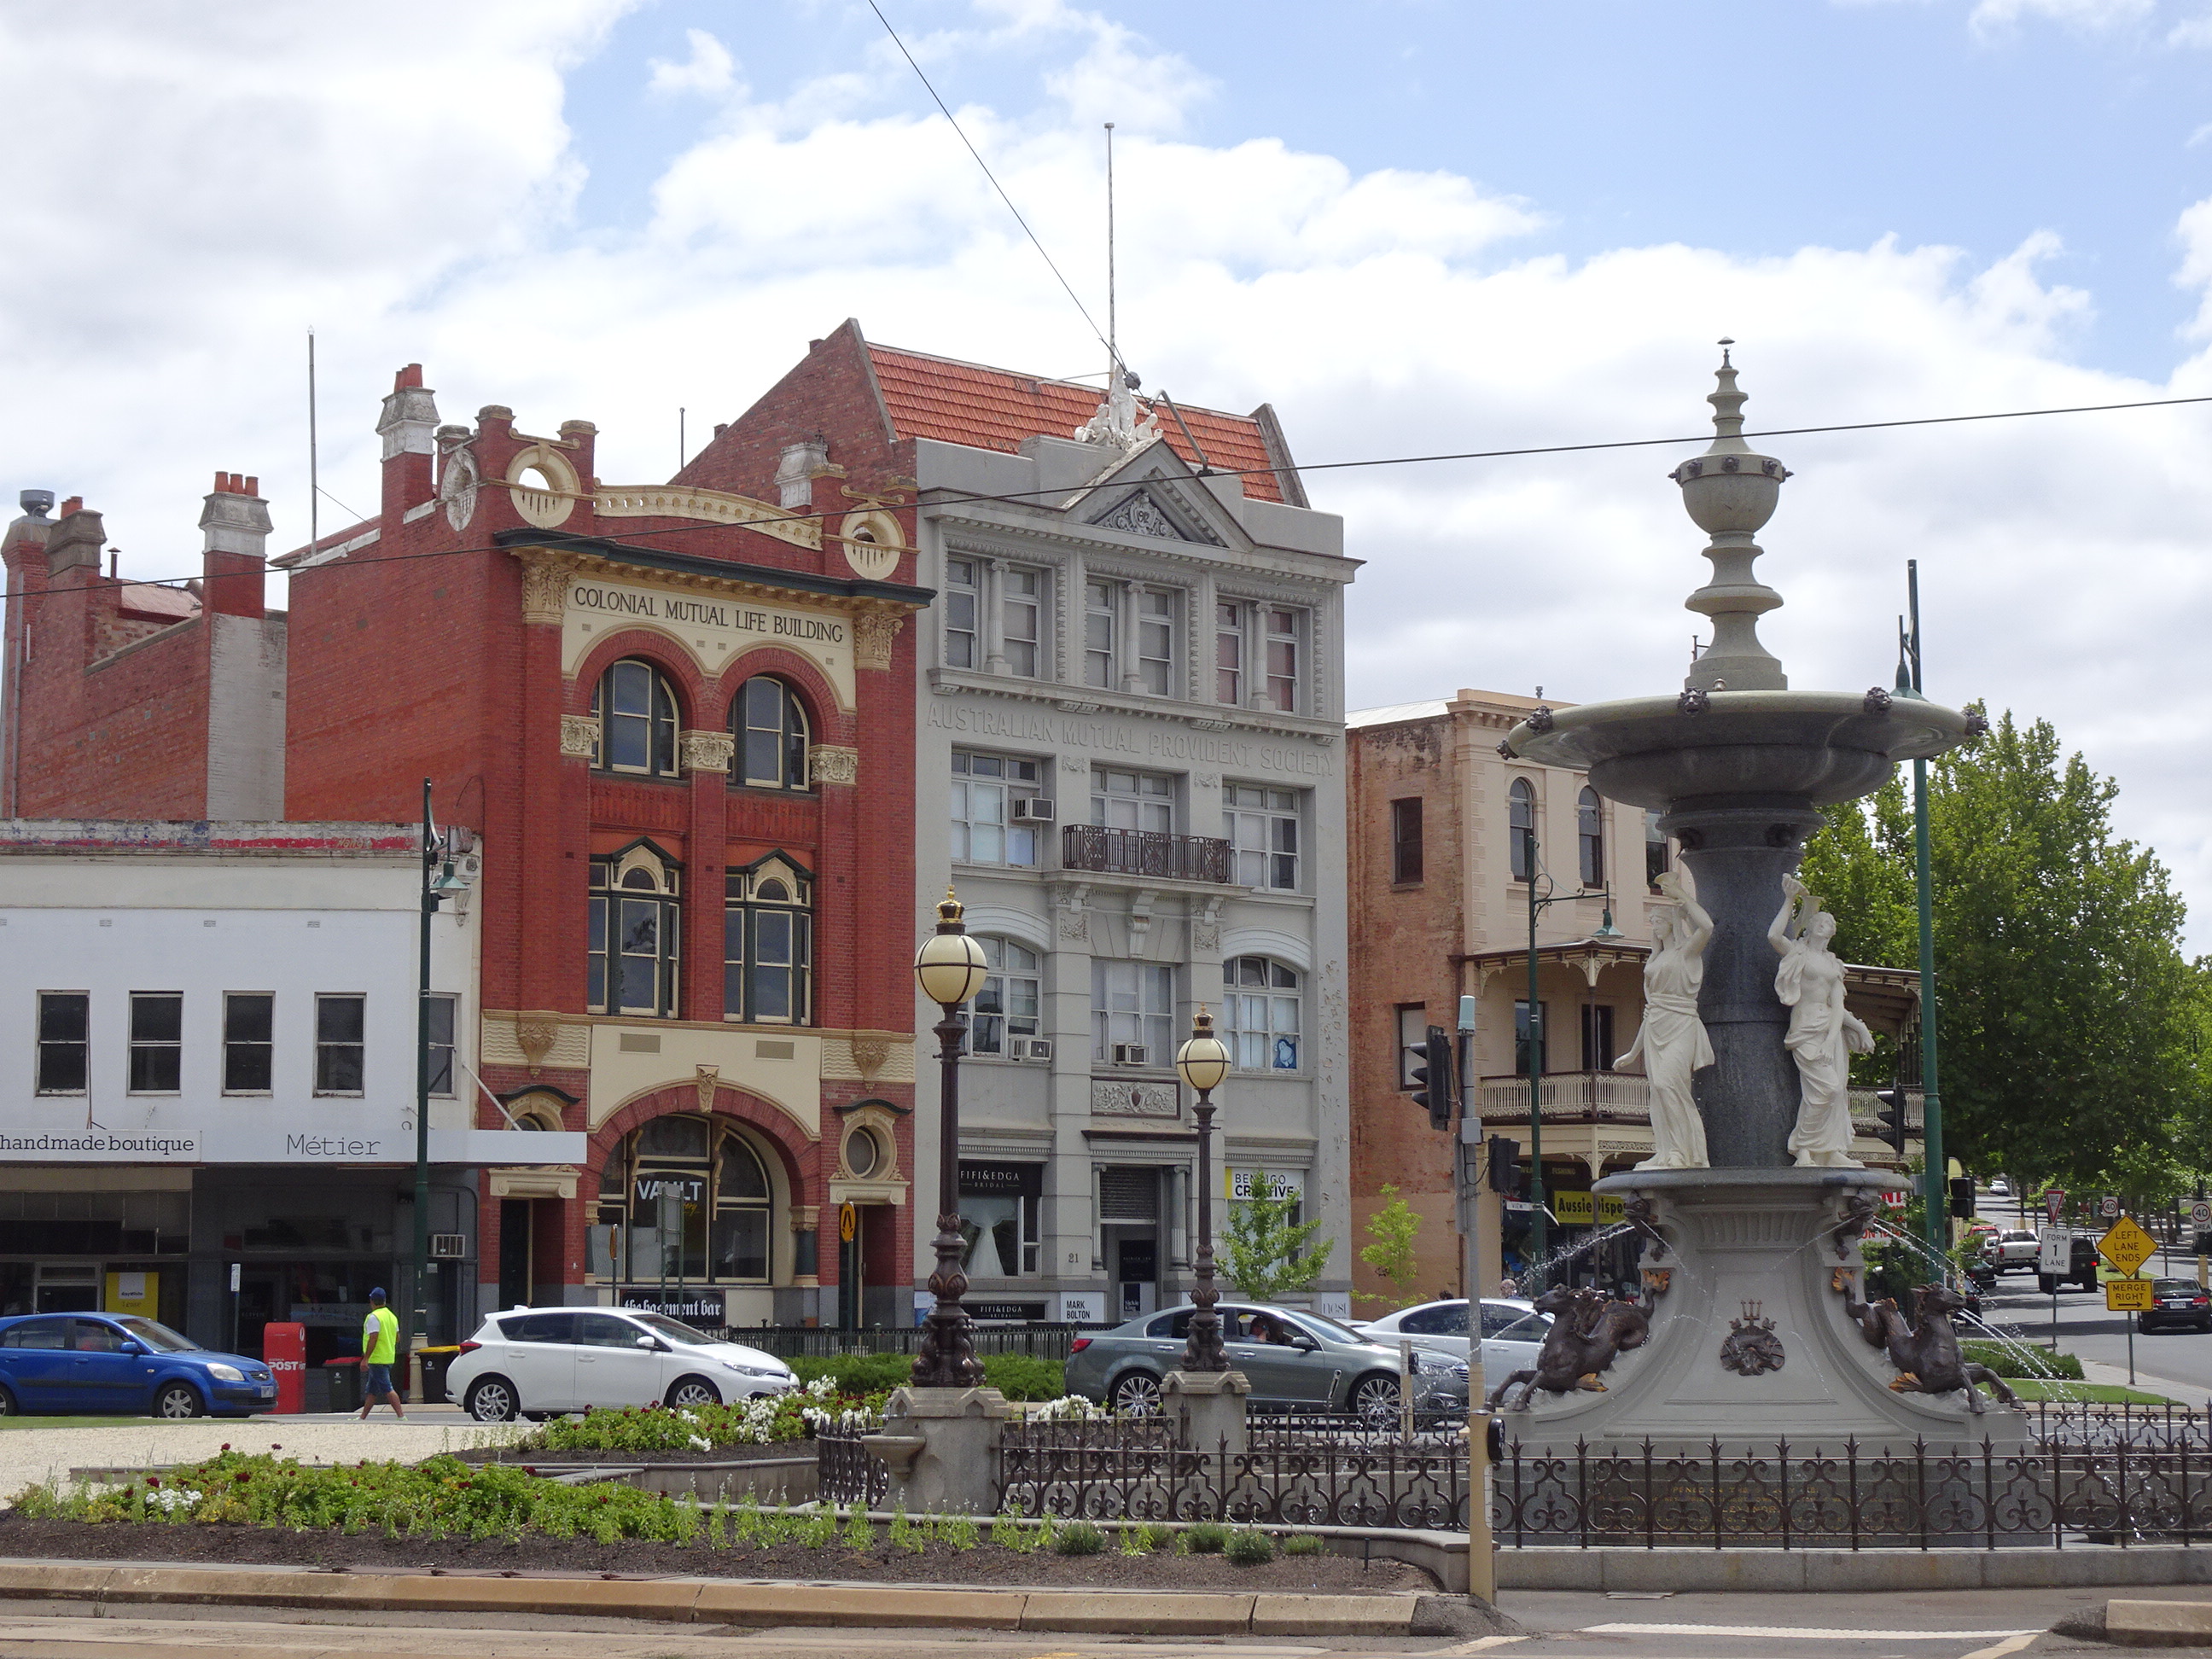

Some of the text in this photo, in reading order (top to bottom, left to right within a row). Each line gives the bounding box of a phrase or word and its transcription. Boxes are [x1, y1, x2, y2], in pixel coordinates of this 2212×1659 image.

[575, 587, 843, 643] COLONIAL MUTUAL LIFE BUILDING
[927, 701, 1334, 777] AUSTRALIAN MUTUAL PROVIDENT SOCIETY
[0, 1134, 195, 1155] handmade boutique
[287, 1134, 381, 1155] Métier
[960, 1170, 1020, 1180] FIFI&EDGA
[1235, 1174, 1286, 1185] BENIGO
[637, 1180, 702, 1201] VALT
[1235, 1185, 1294, 1197] CRIVE
[1558, 1197, 1592, 1213] Aussie
[2195, 1208, 2208, 1217] 40
[2053, 1244, 2058, 1256] 1
[2114, 1243, 2139, 1251] LANE
[1068, 1253, 1079, 1263] 21
[701, 1299, 721, 1316] bar
[1066, 1301, 1086, 1309] MARK
[1066, 1310, 1091, 1319] BOLTON
[268, 1361, 299, 1371] POST
